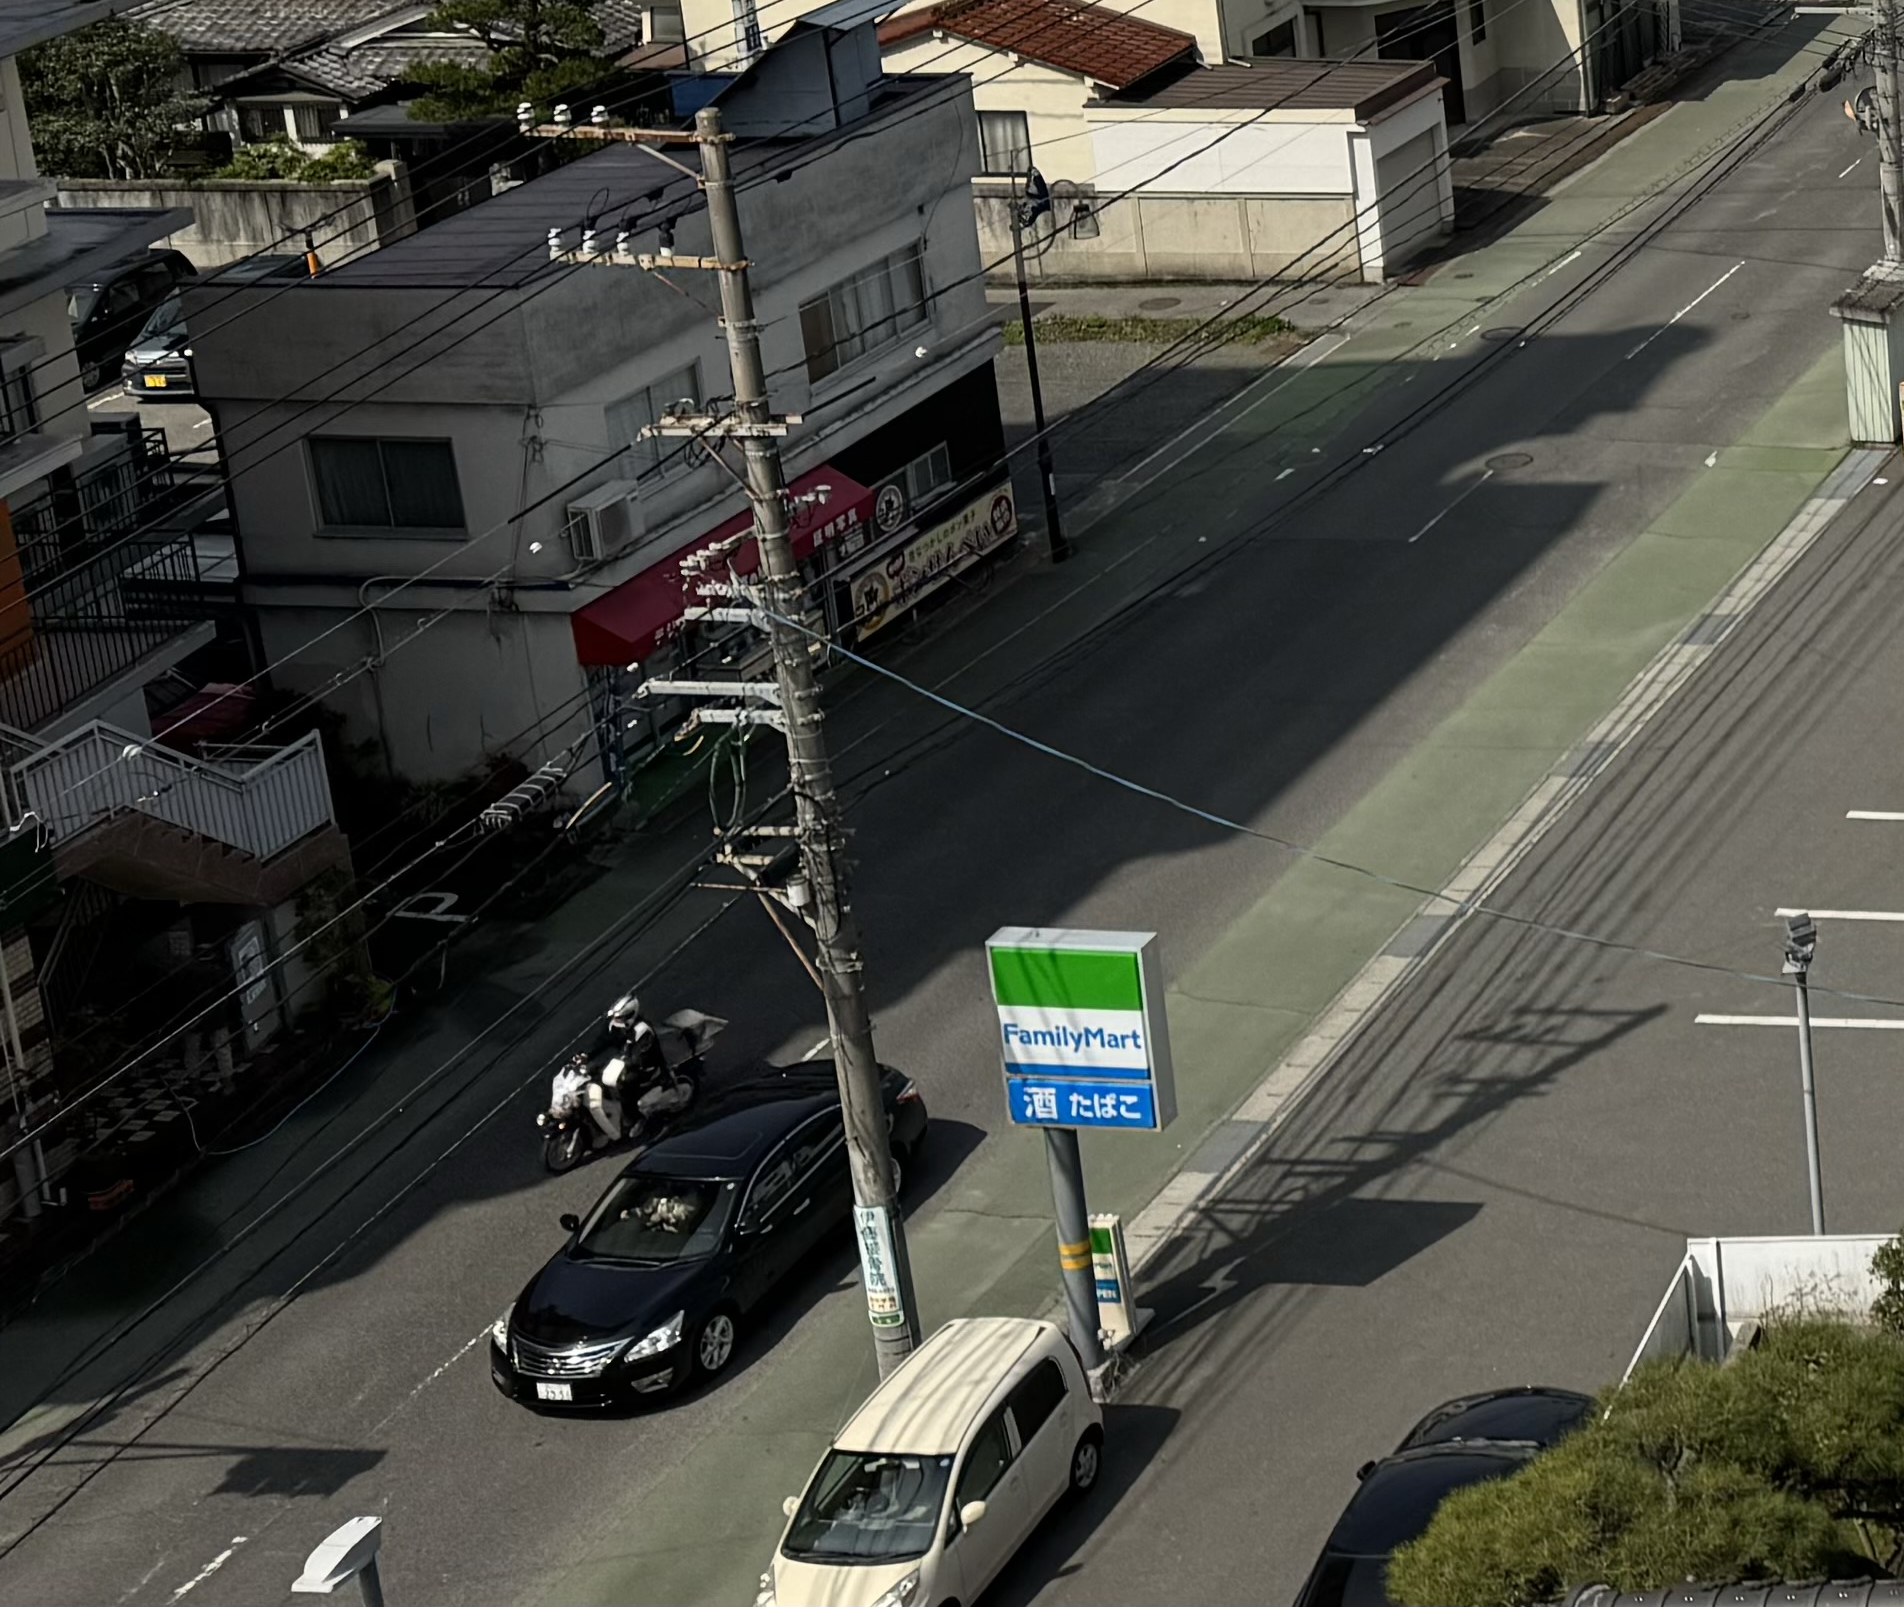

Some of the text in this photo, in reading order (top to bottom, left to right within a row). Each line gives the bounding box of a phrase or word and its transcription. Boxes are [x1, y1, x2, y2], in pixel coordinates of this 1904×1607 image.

[812, 507, 859, 548] 証明写真
[1003, 1023, 1143, 1053] FamilyMart
[1023, 1086, 1142, 1120] 酒 たばこ
